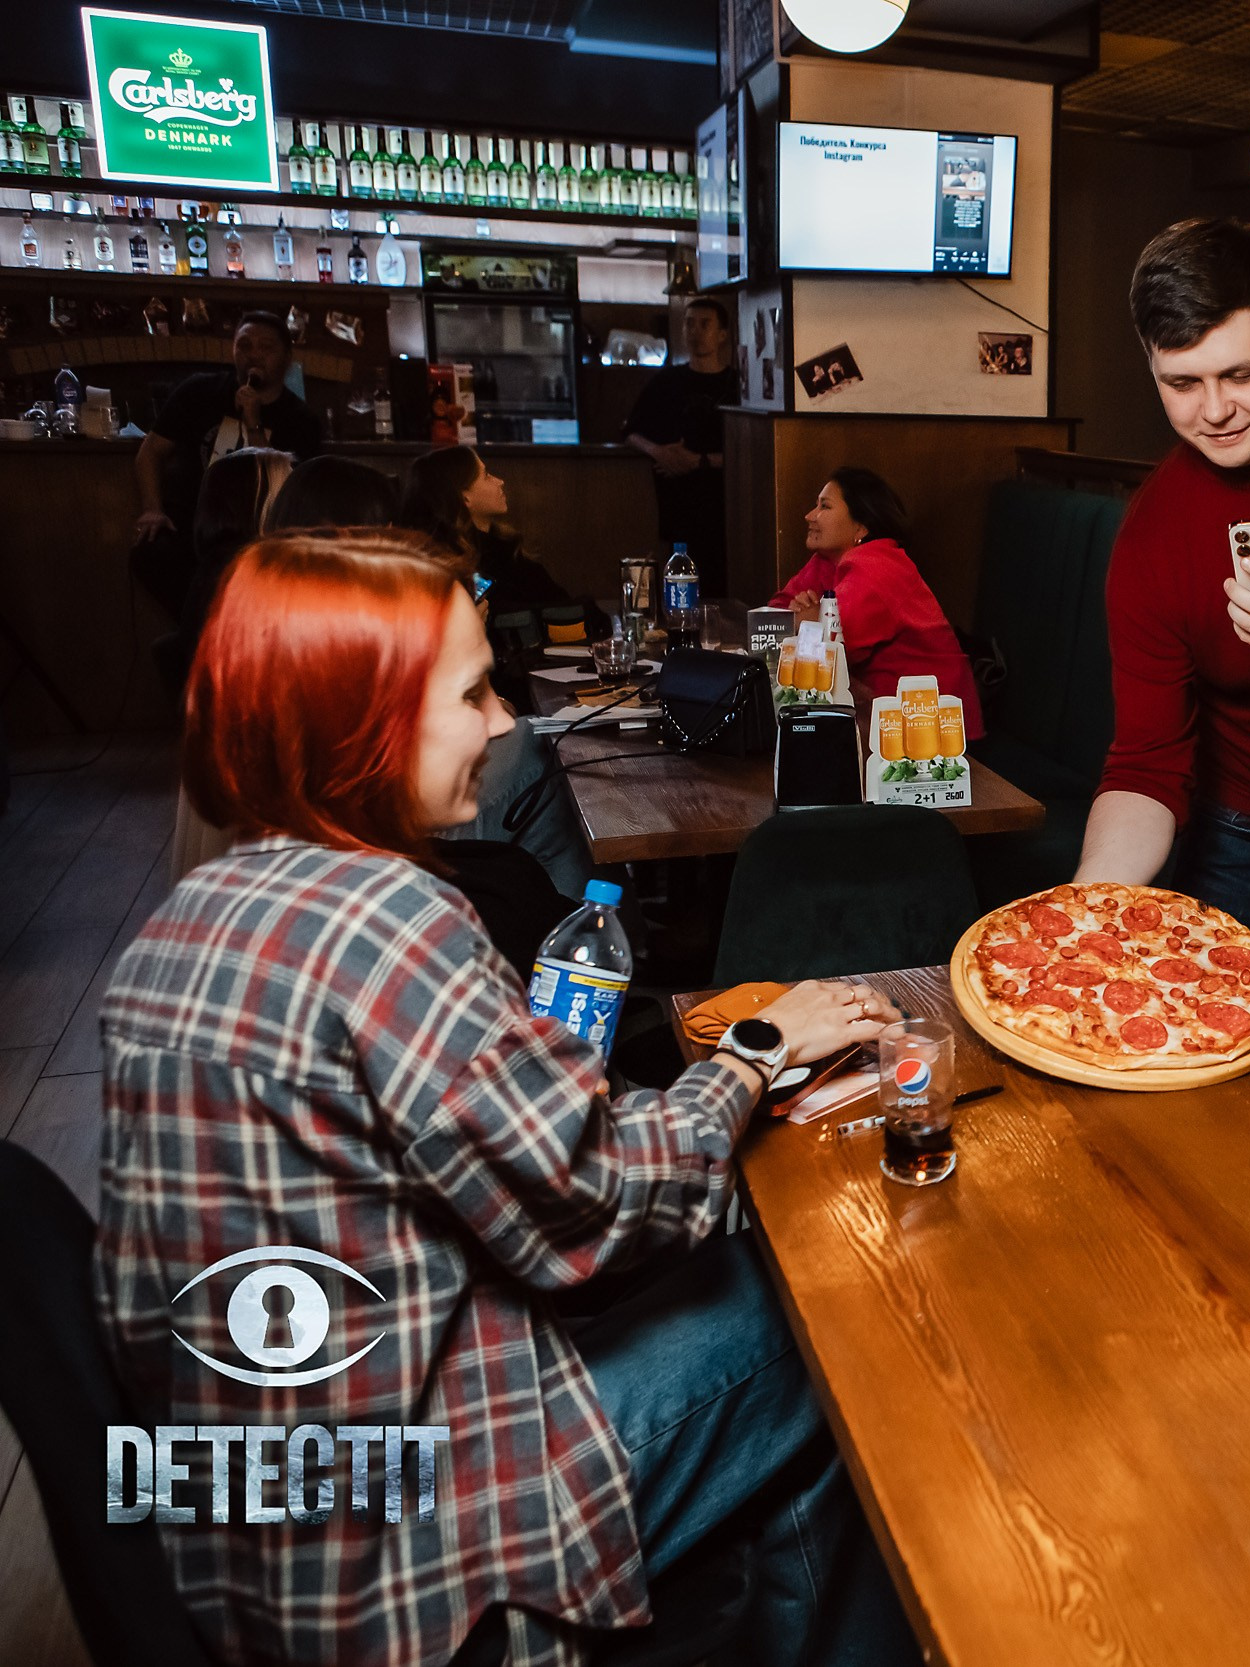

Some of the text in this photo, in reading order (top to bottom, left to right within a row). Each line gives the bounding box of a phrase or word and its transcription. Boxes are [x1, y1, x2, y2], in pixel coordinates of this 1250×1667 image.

[108, 67, 257, 124] Carlsberg
[144, 128, 233, 147] DENMARK
[800, 136, 887, 151] Победитель Конкурса
[824, 150, 863, 162] Instagram
[751, 634, 776, 643] ЯРД
[751, 642, 782, 651] ВИСК
[914, 792, 936, 805] 2+1
[945, 790, 964, 801] 2600
[566, 992, 588, 1035] EPSI
